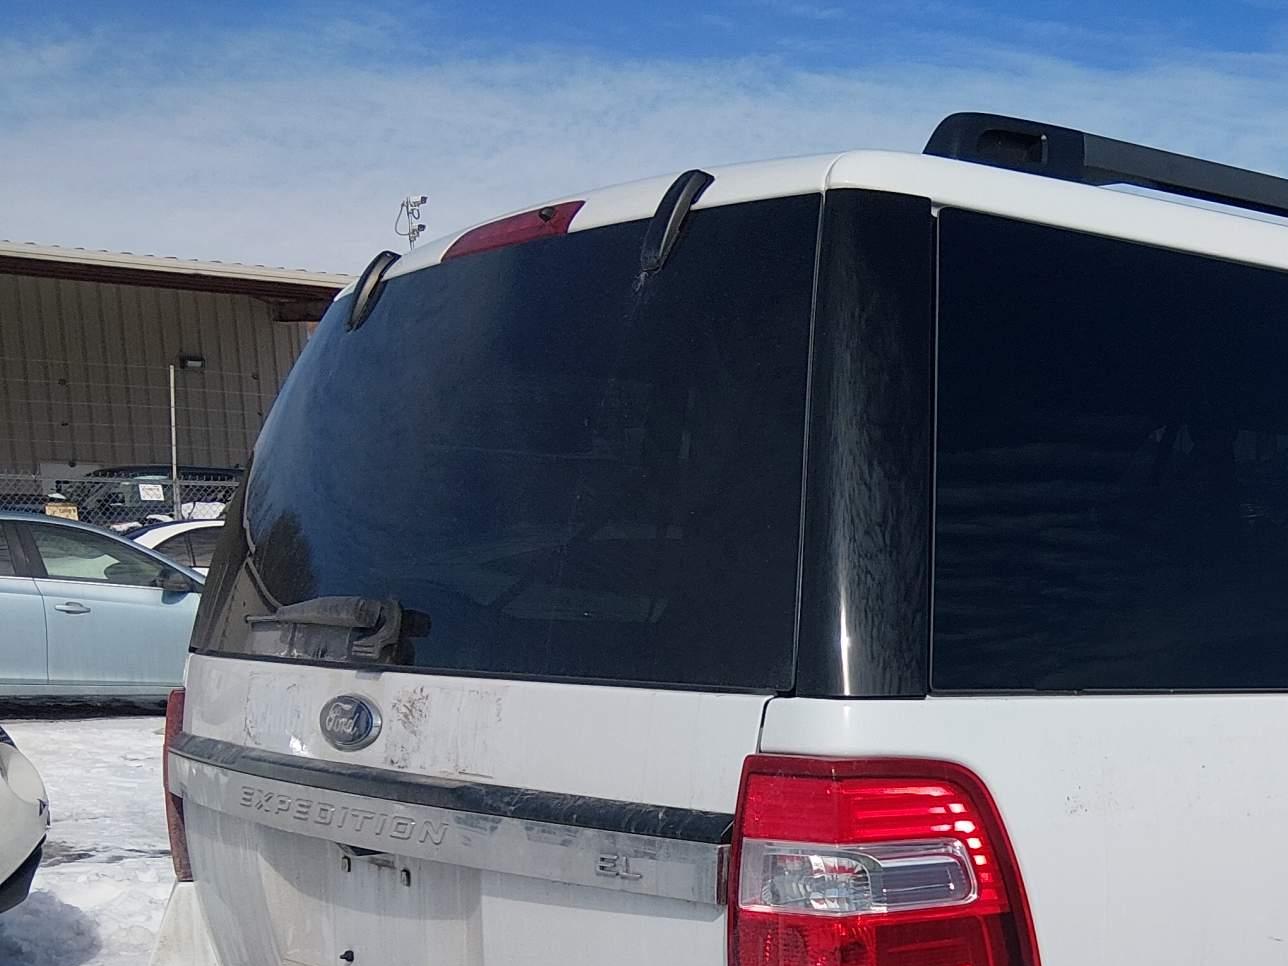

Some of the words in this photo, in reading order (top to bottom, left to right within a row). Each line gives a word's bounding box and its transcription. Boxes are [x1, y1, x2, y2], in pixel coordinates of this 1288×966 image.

[325, 701, 358, 735] Ford
[239, 785, 449, 846] EXPEDITION
[595, 853, 643, 880] EL
